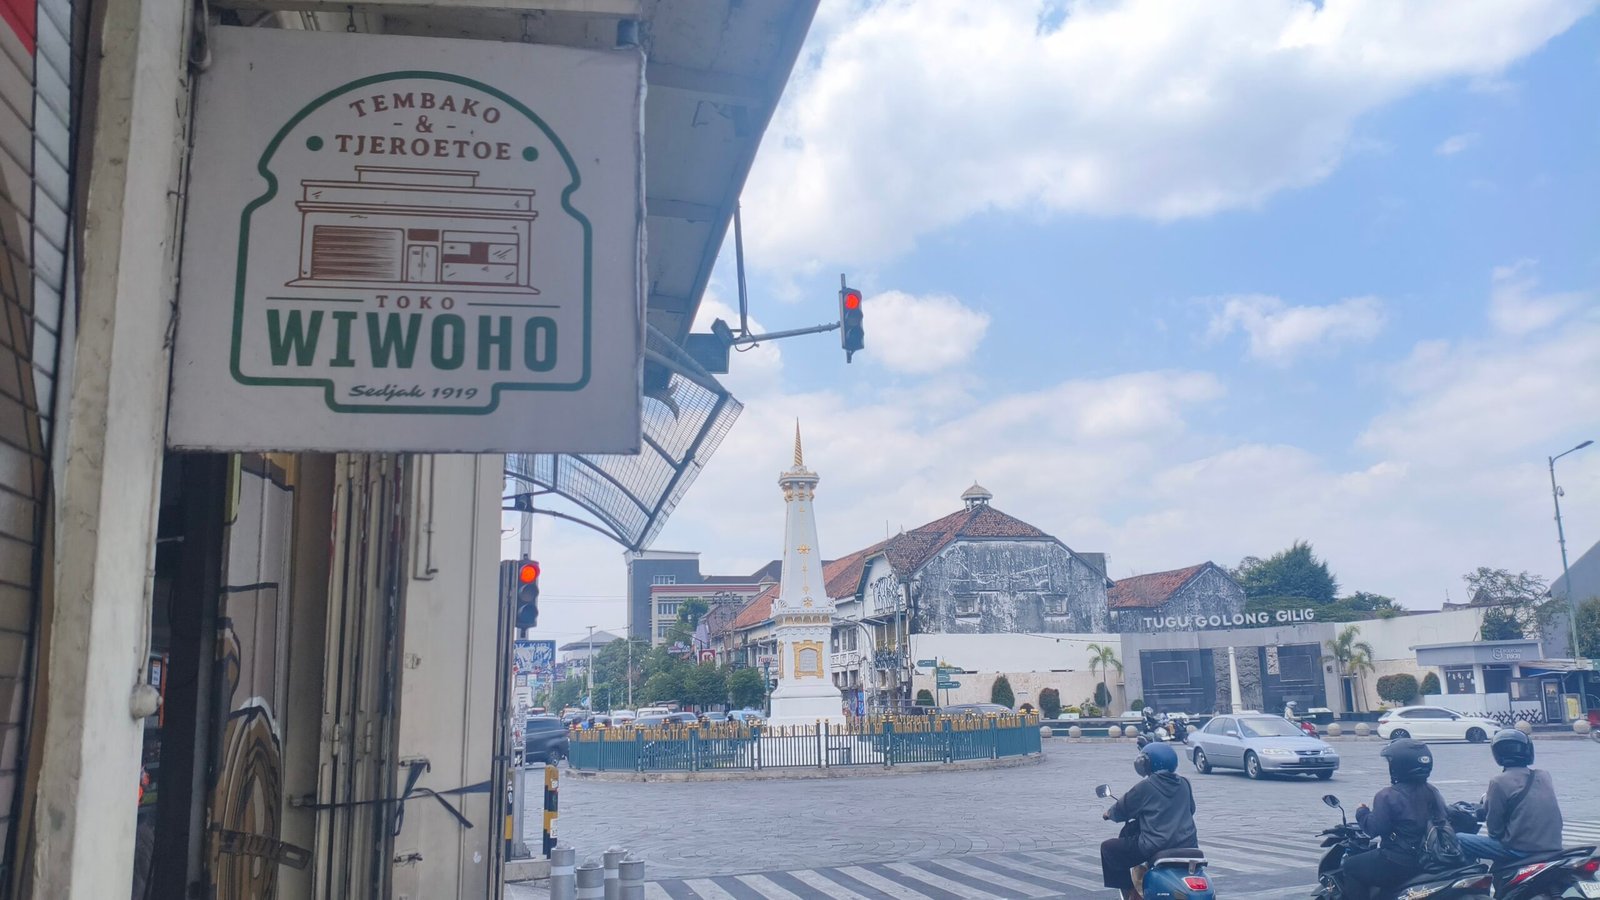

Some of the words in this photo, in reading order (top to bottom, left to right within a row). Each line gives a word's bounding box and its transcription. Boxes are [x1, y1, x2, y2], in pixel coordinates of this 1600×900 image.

[349, 92, 501, 124] TEMBAKO
[415, 114, 434, 134] &
[335, 134, 512, 161] TJEROETOE
[376, 295, 455, 310] TOKO
[266, 309, 558, 372] WIWOHO
[348, 384, 426, 402] Sedjak
[432, 387, 479, 400] 1919
[1143, 615, 1189, 629] TUGU
[1195, 612, 1269, 627] GOLONG
[1275, 608, 1315, 623] GILIG
